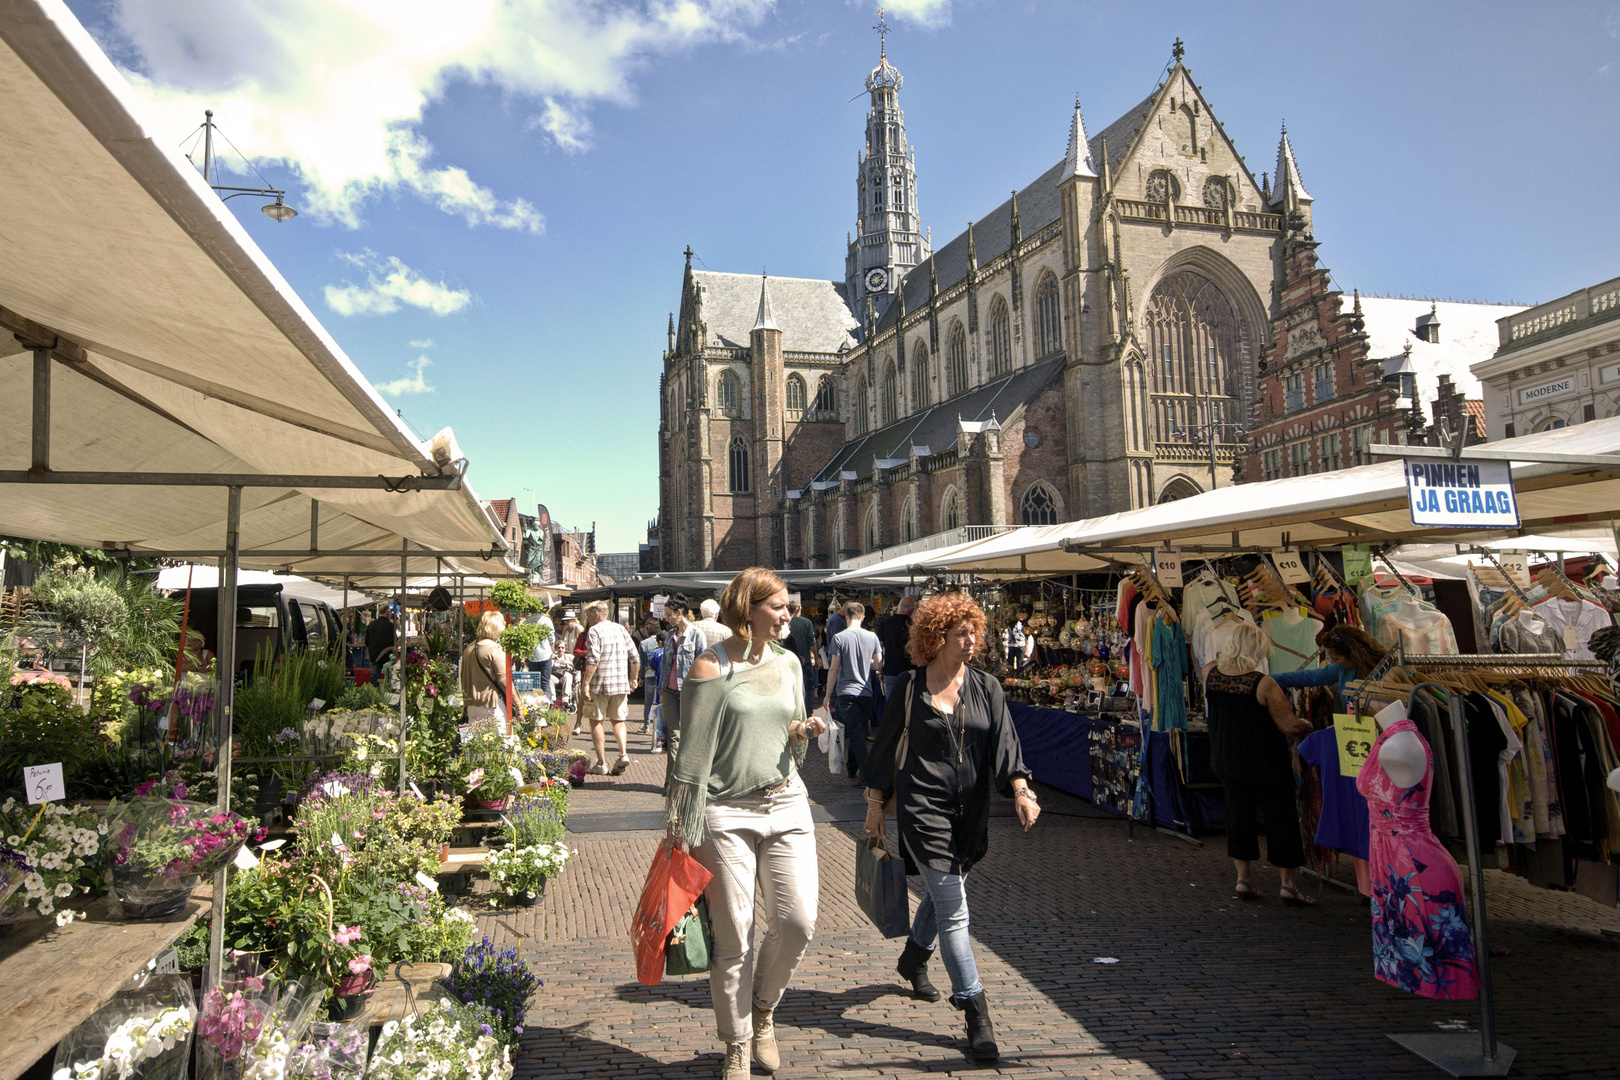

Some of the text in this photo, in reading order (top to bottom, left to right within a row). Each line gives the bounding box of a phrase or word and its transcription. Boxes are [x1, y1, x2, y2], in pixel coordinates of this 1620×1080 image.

[1525, 381, 1570, 400] MODERNE
[1411, 463, 1481, 489] PINNEN
[1416, 489, 1512, 515] JA GRAAG
[1158, 561, 1176, 570] €10
[1279, 560, 1298, 569] €10
[1345, 740, 1372, 759] €3
